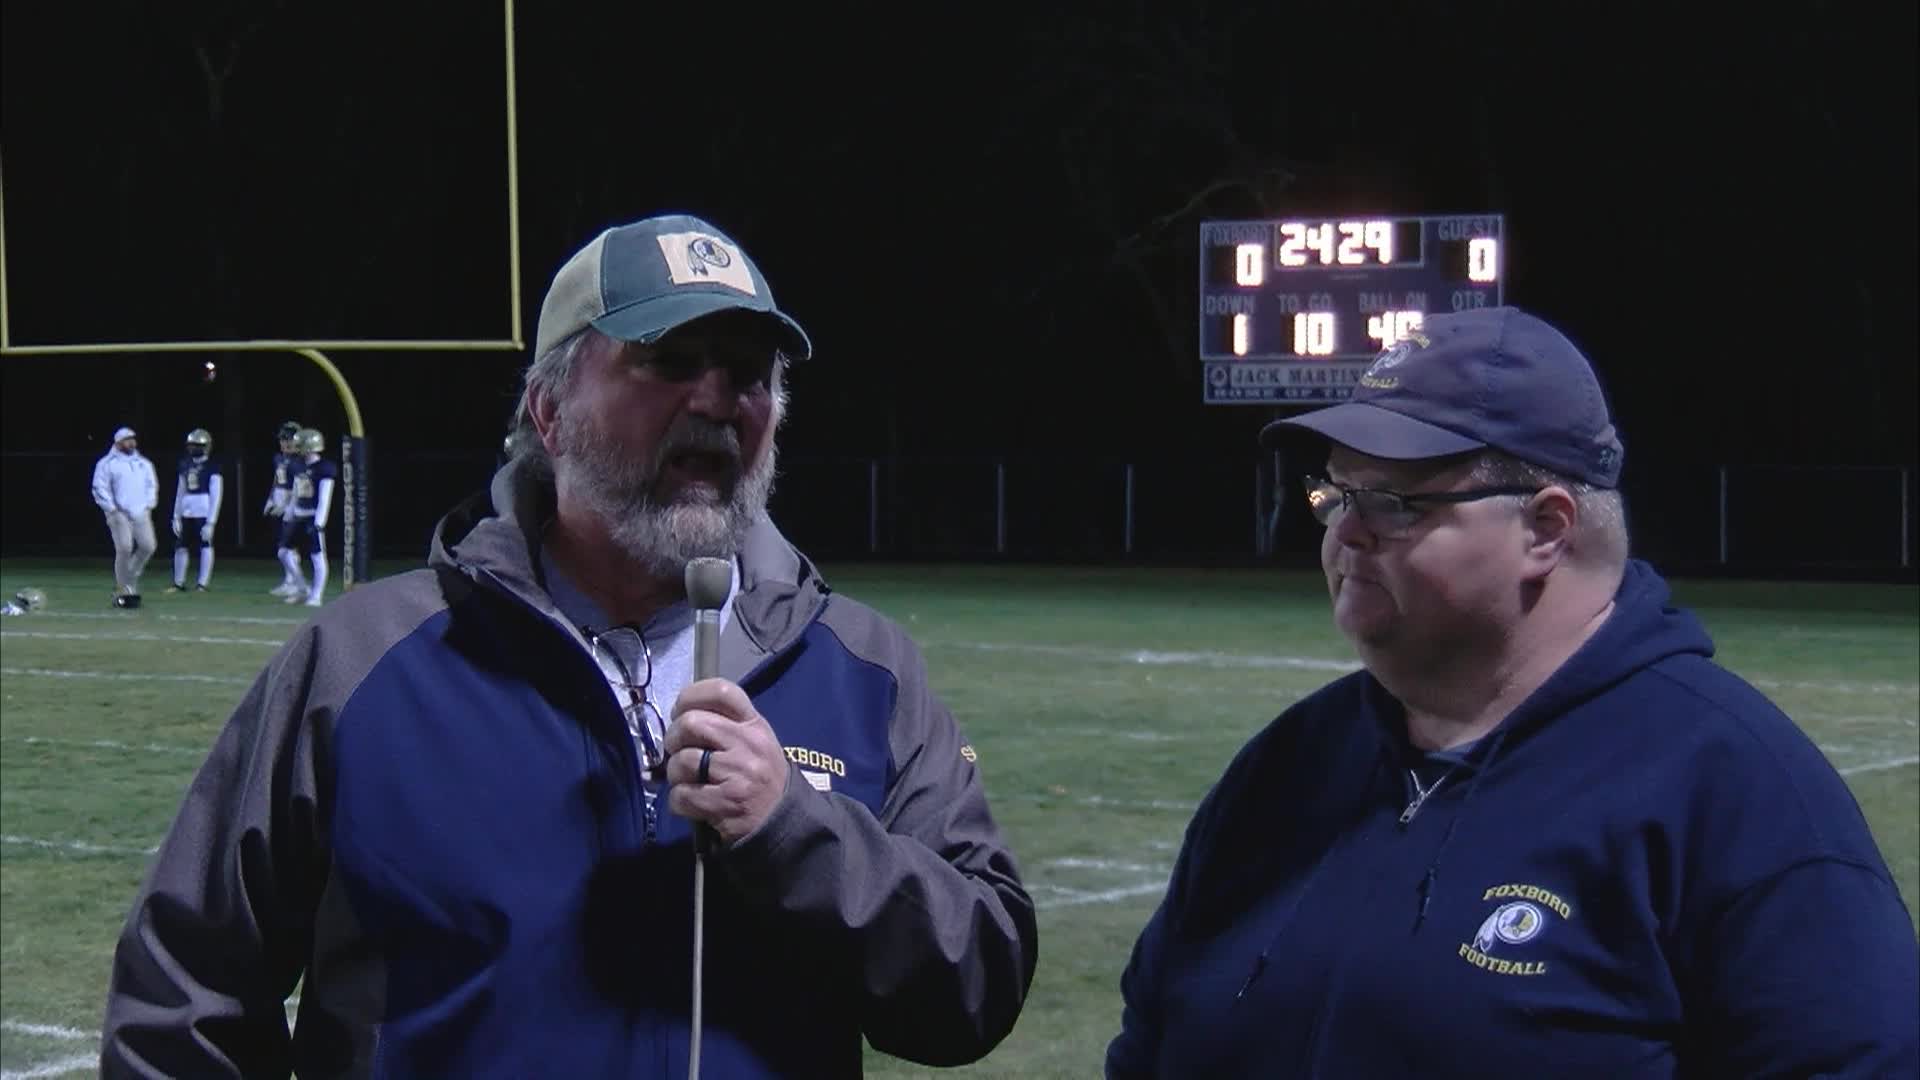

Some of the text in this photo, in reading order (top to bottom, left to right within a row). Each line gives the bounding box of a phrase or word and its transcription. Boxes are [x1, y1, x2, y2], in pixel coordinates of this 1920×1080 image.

[1438, 218, 1496, 240] GUEST
[1236, 244, 1264, 287] 0
[1468, 238, 1497, 282] 0
[1206, 294, 1256, 316] DOWN
[1278, 292, 1333, 314] TO GO
[1359, 291, 1427, 313] BALL ON
[1233, 313, 1248, 357] 1
[1294, 312, 1334, 356] 10
[1236, 366, 1367, 383] JACK MARTIN
[784, 747, 845, 777] XBORO
[1483, 884, 1571, 920] FOXBORO
[1459, 943, 1546, 975] FOOTBALL
